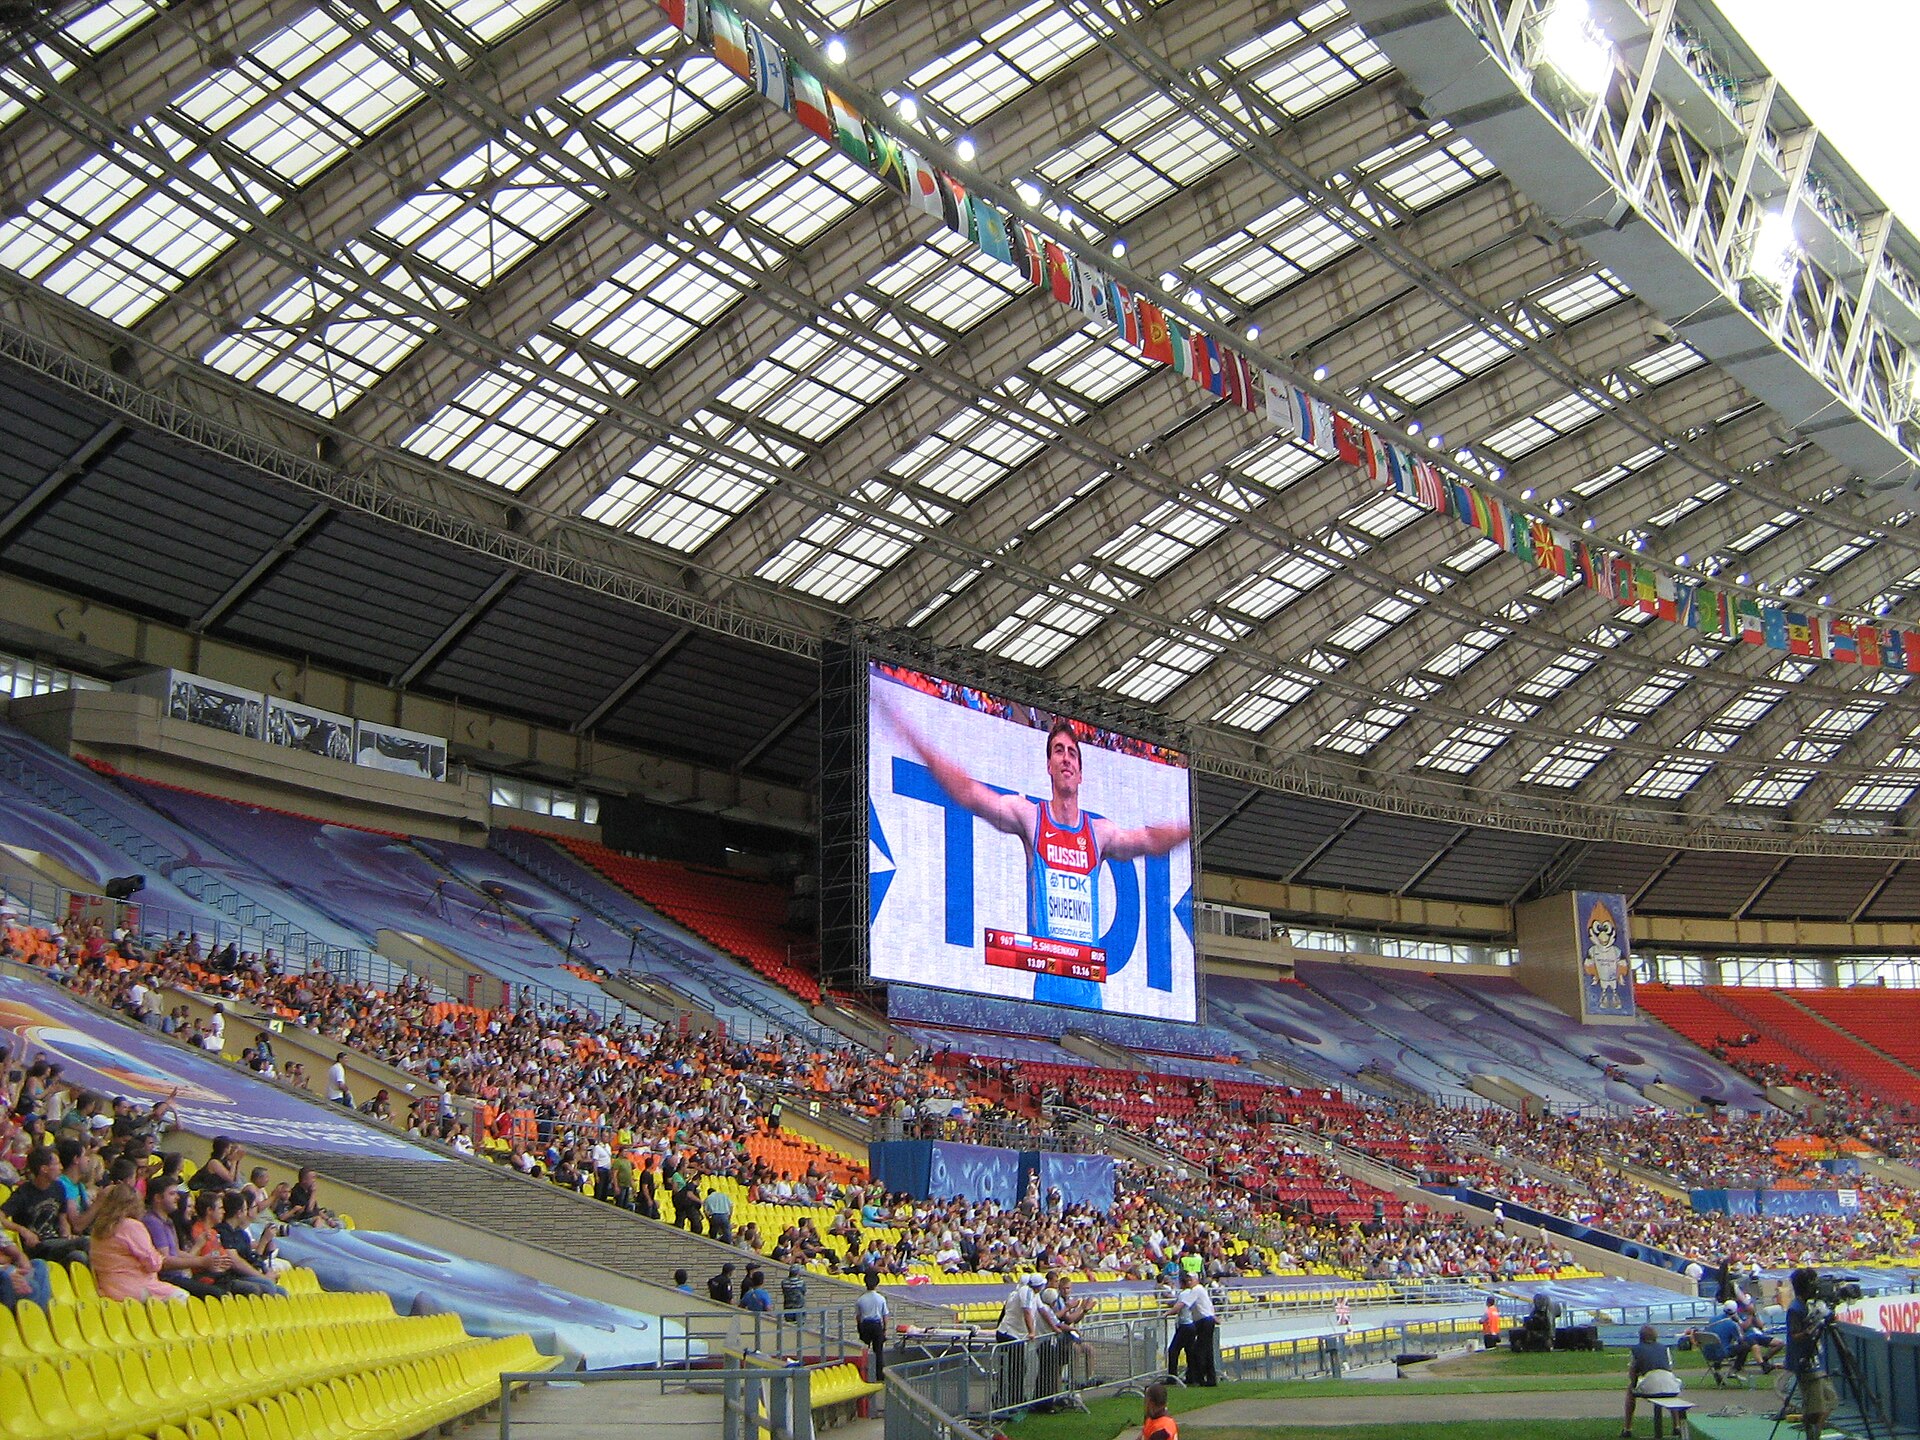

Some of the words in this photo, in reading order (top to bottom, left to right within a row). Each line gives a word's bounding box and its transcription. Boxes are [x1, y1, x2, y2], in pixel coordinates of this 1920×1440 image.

[1047, 844, 1089, 869] RUSSIA
[1059, 874, 1087, 893] TDK
[1049, 896, 1090, 922] SHUBENKOV
[1000, 935, 1014, 946] 967
[1091, 951, 1105, 961] RUS
[1072, 965, 1090, 976] 13.16
